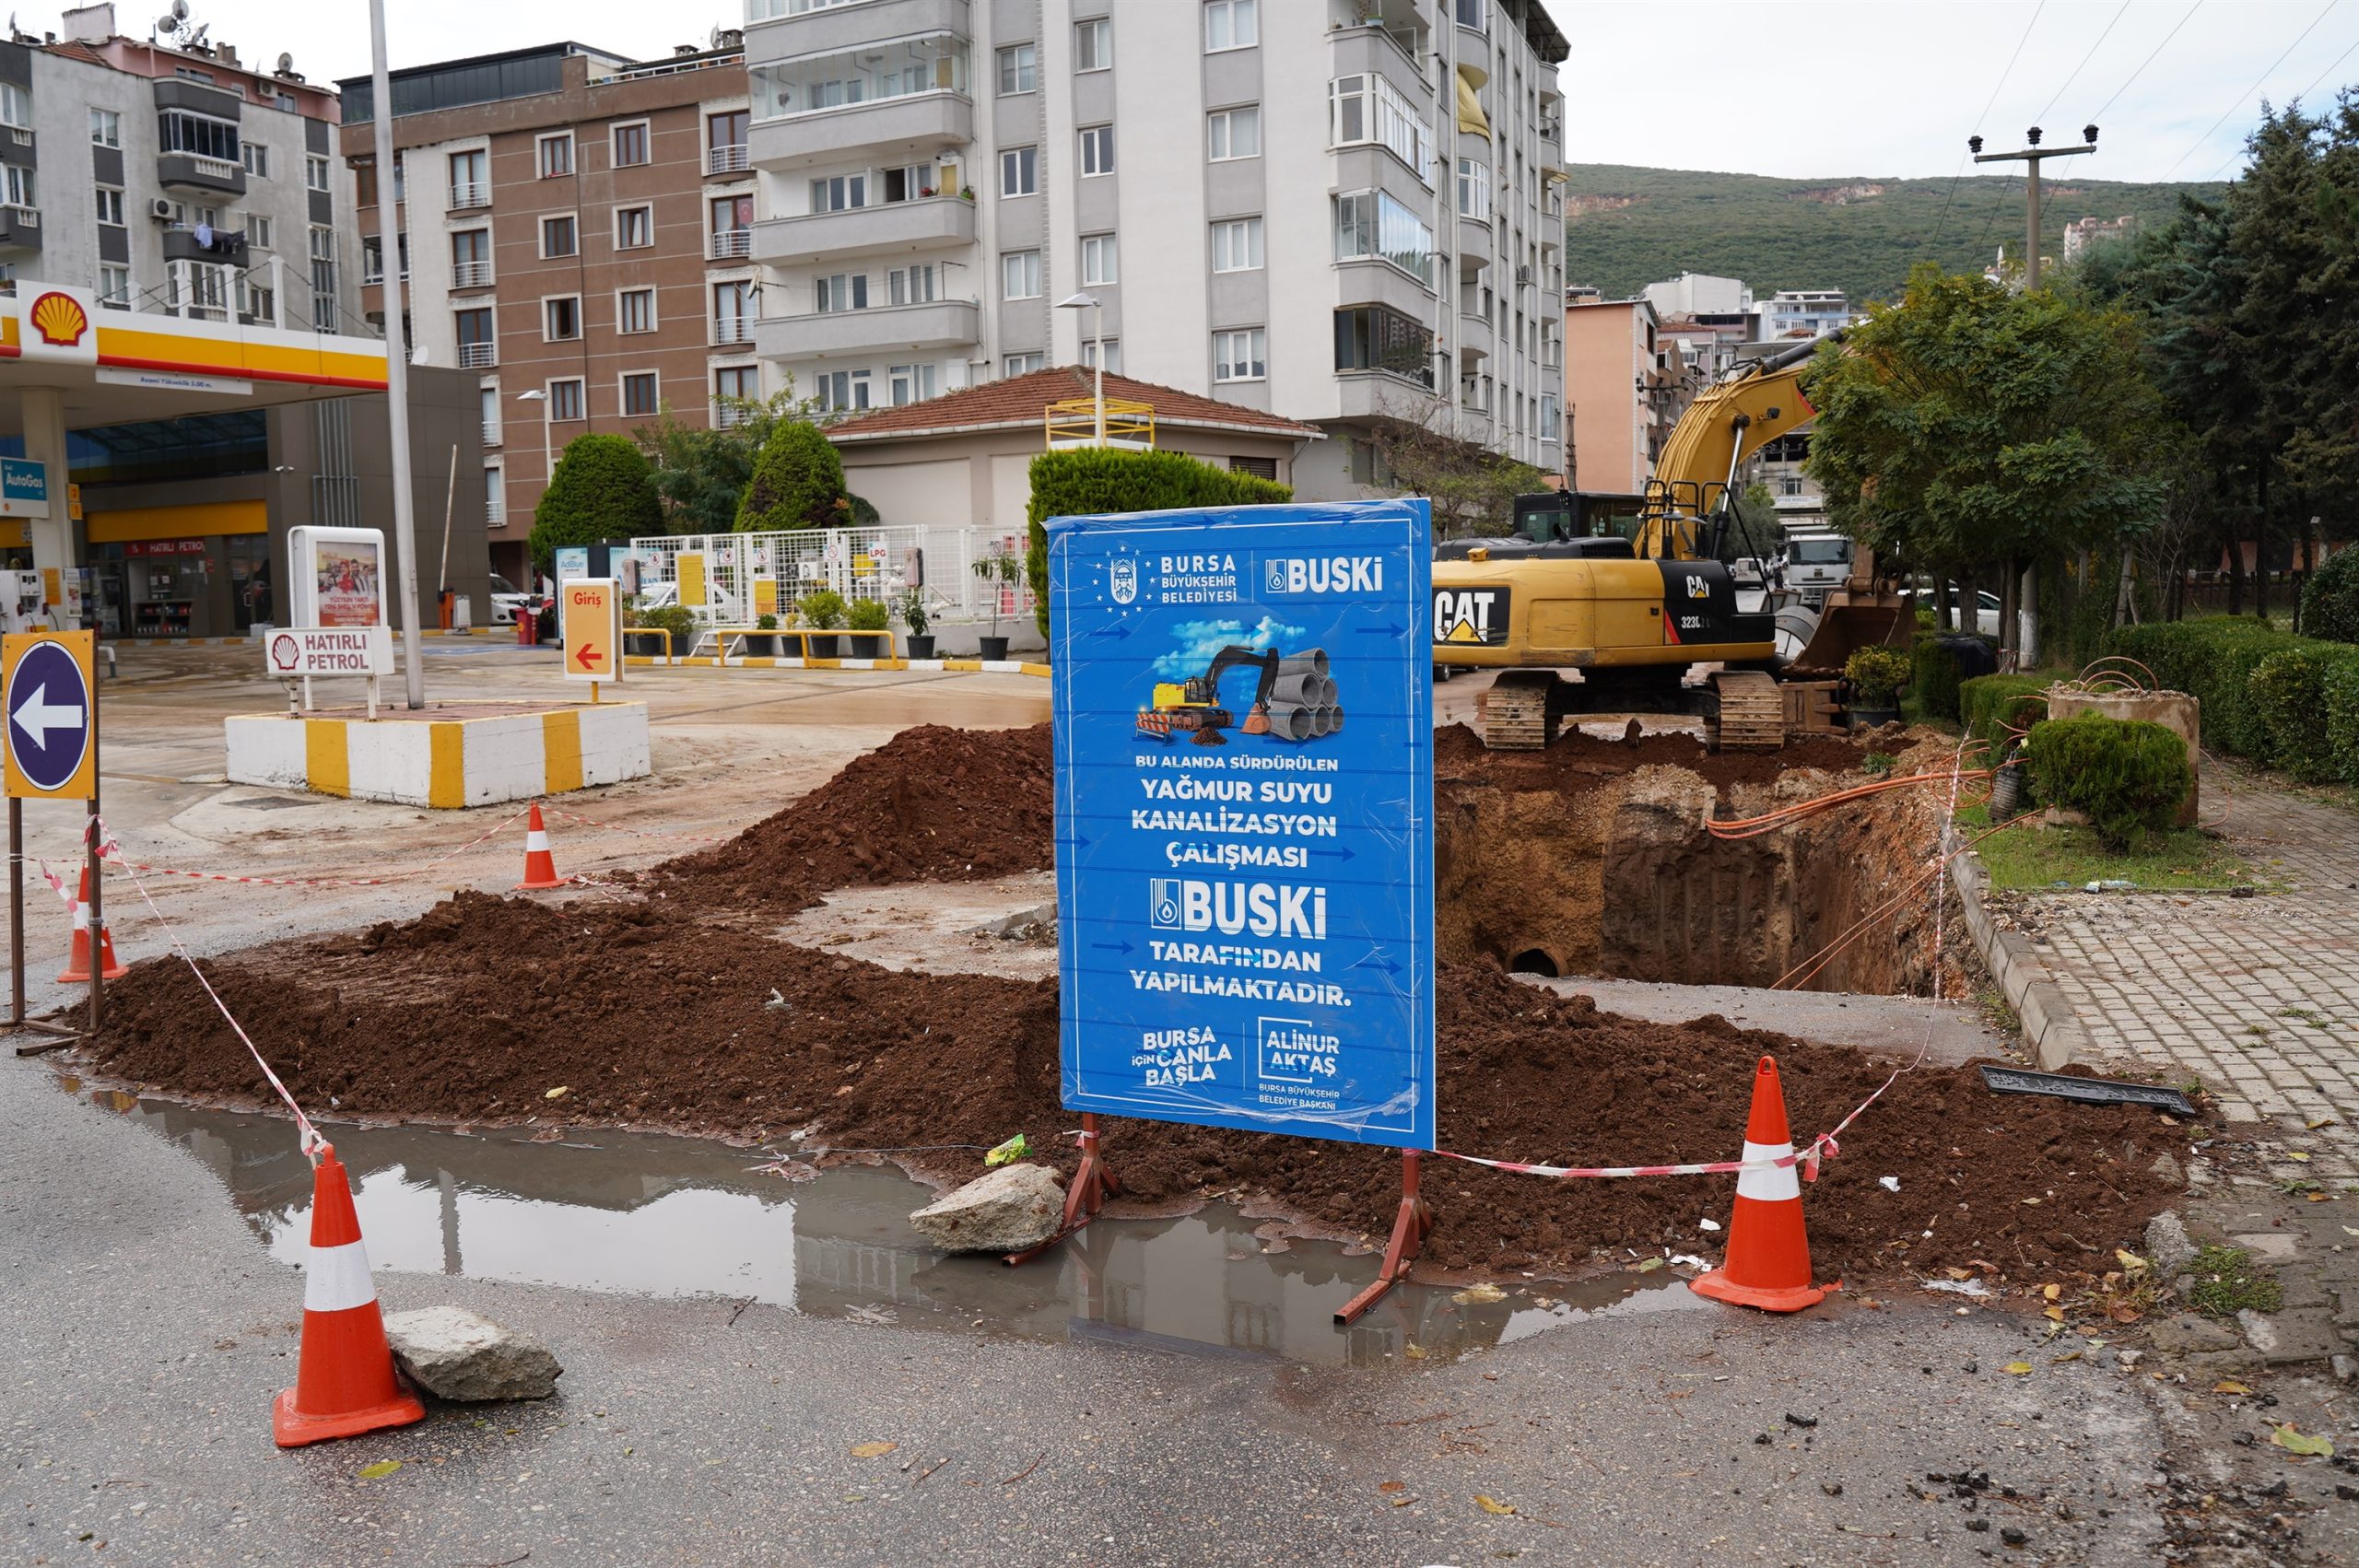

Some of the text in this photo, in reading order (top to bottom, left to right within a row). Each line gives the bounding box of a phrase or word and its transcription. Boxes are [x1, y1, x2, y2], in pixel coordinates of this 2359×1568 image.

[6, 472, 43, 488] AutoGas
[149, 542, 175, 553] HATIRLI
[870, 549, 886, 557] LPG
[1161, 555, 1237, 573] BURSA
[1162, 572, 1237, 588] BÜYÜKŞEHİR
[574, 591, 602, 608] Giriş
[1162, 588, 1238, 603] BELEDİYESİ
[1434, 591, 1495, 642] CAT
[305, 634, 367, 650] HATIRLI
[307, 654, 369, 670] PETROL
[1135, 755, 1339, 773] BU ALANDA SÜRDÜRÜLEN
[1141, 774, 1332, 804] YAĞMUR SUYU
[1132, 805, 1337, 837] KANALİZASYON
[1166, 842, 1309, 871] ÇALIŞMASI
[1149, 940, 1321, 973] TARAFINDAN
[1129, 969, 1353, 1007] YAPILMAKTADIR.
[1143, 1025, 1217, 1050] BURSA
[1266, 1028, 1340, 1055] ALİNUR
[1156, 1043, 1233, 1068] CANLA
[1270, 1051, 1337, 1078] AKTAŞ
[1145, 1063, 1216, 1087] BAŞLA
[1259, 1082, 1341, 1099] BURSA BÜYÜKŞEHİR
[1259, 1094, 1336, 1111] BELEDİYE BAŞKANI
